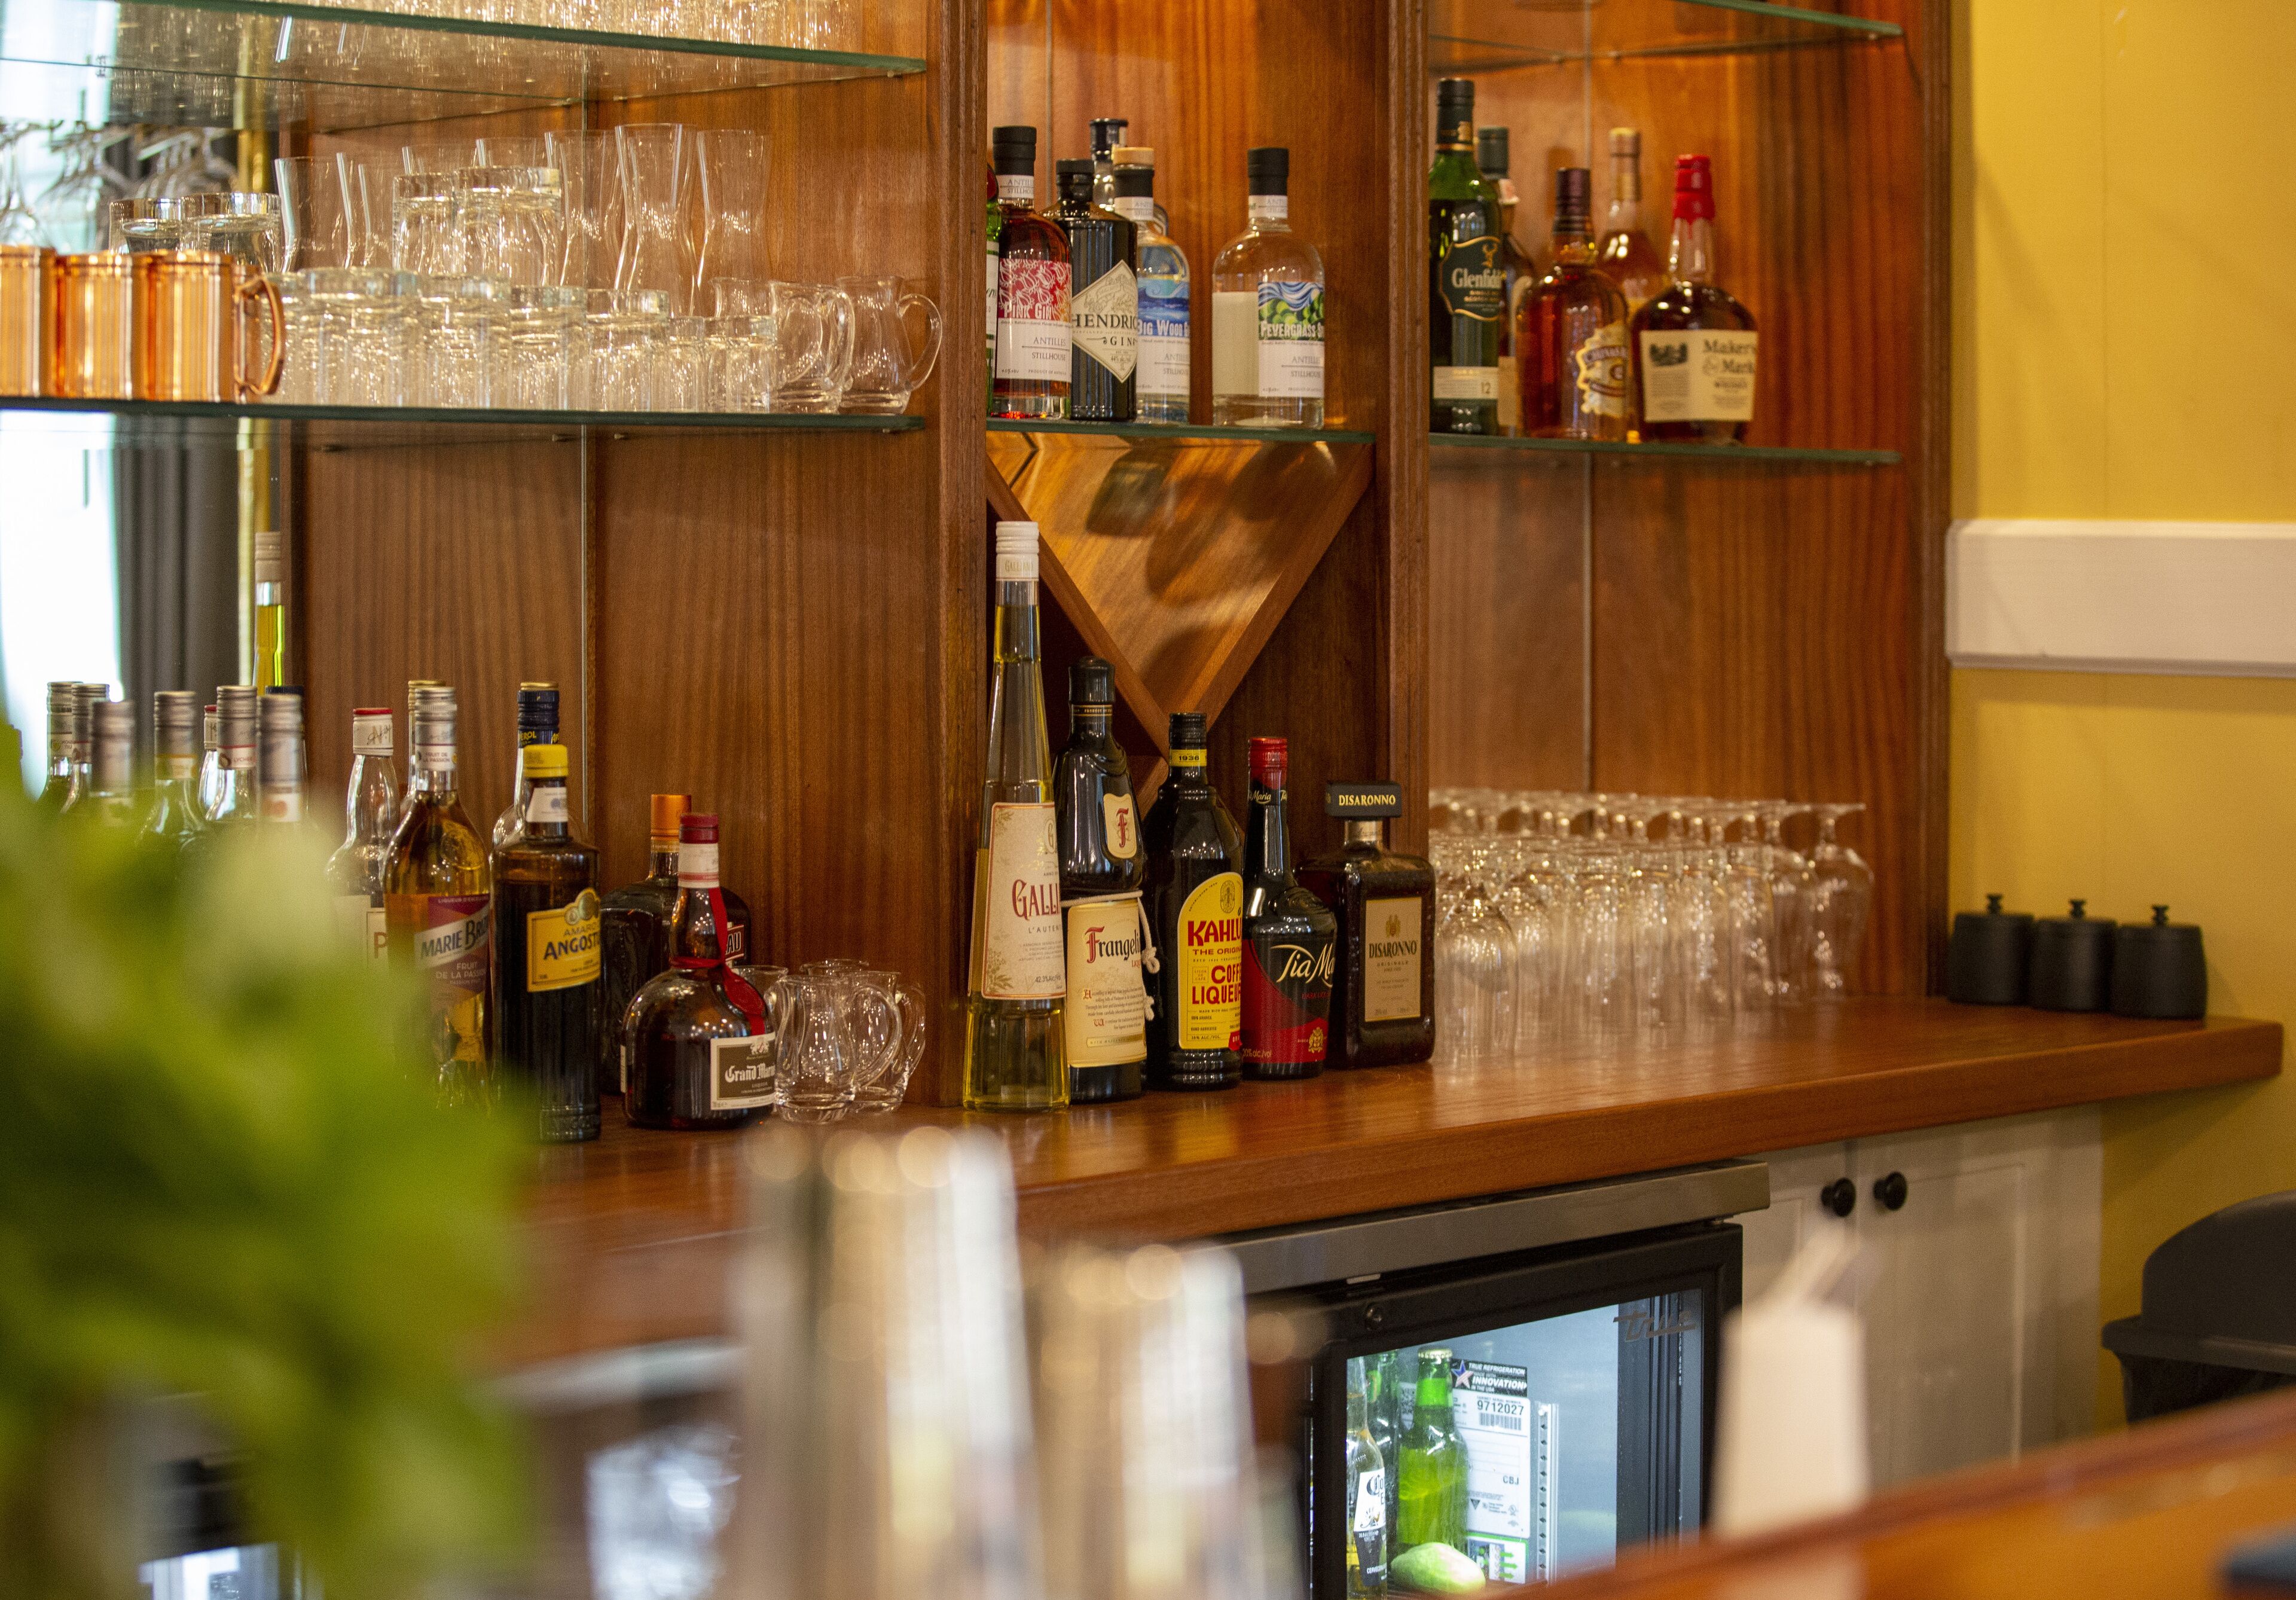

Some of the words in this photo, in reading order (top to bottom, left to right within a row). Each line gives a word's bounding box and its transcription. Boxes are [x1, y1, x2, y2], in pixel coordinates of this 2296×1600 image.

[1004, 302, 1030, 318] PINK
[1035, 303, 1052, 319] GIN
[1033, 337, 1067, 347] ANTILLES
[1032, 352, 1067, 361] STILLHOUSE
[1338, 794, 1396, 806] DISARONNO
[421, 930, 463, 960] MARIE
[1369, 939, 1417, 958] DISARONNO
[456, 961, 477, 970] FRUIT
[1270, 944, 1316, 983] Tia
[435, 971, 448, 979] DE
[451, 970, 462, 979] LA
[725, 1064, 757, 1083] Grand
[1483, 1364, 1526, 1375] REFRIGERATION
[1476, 1400, 1524, 1416] 9712027
